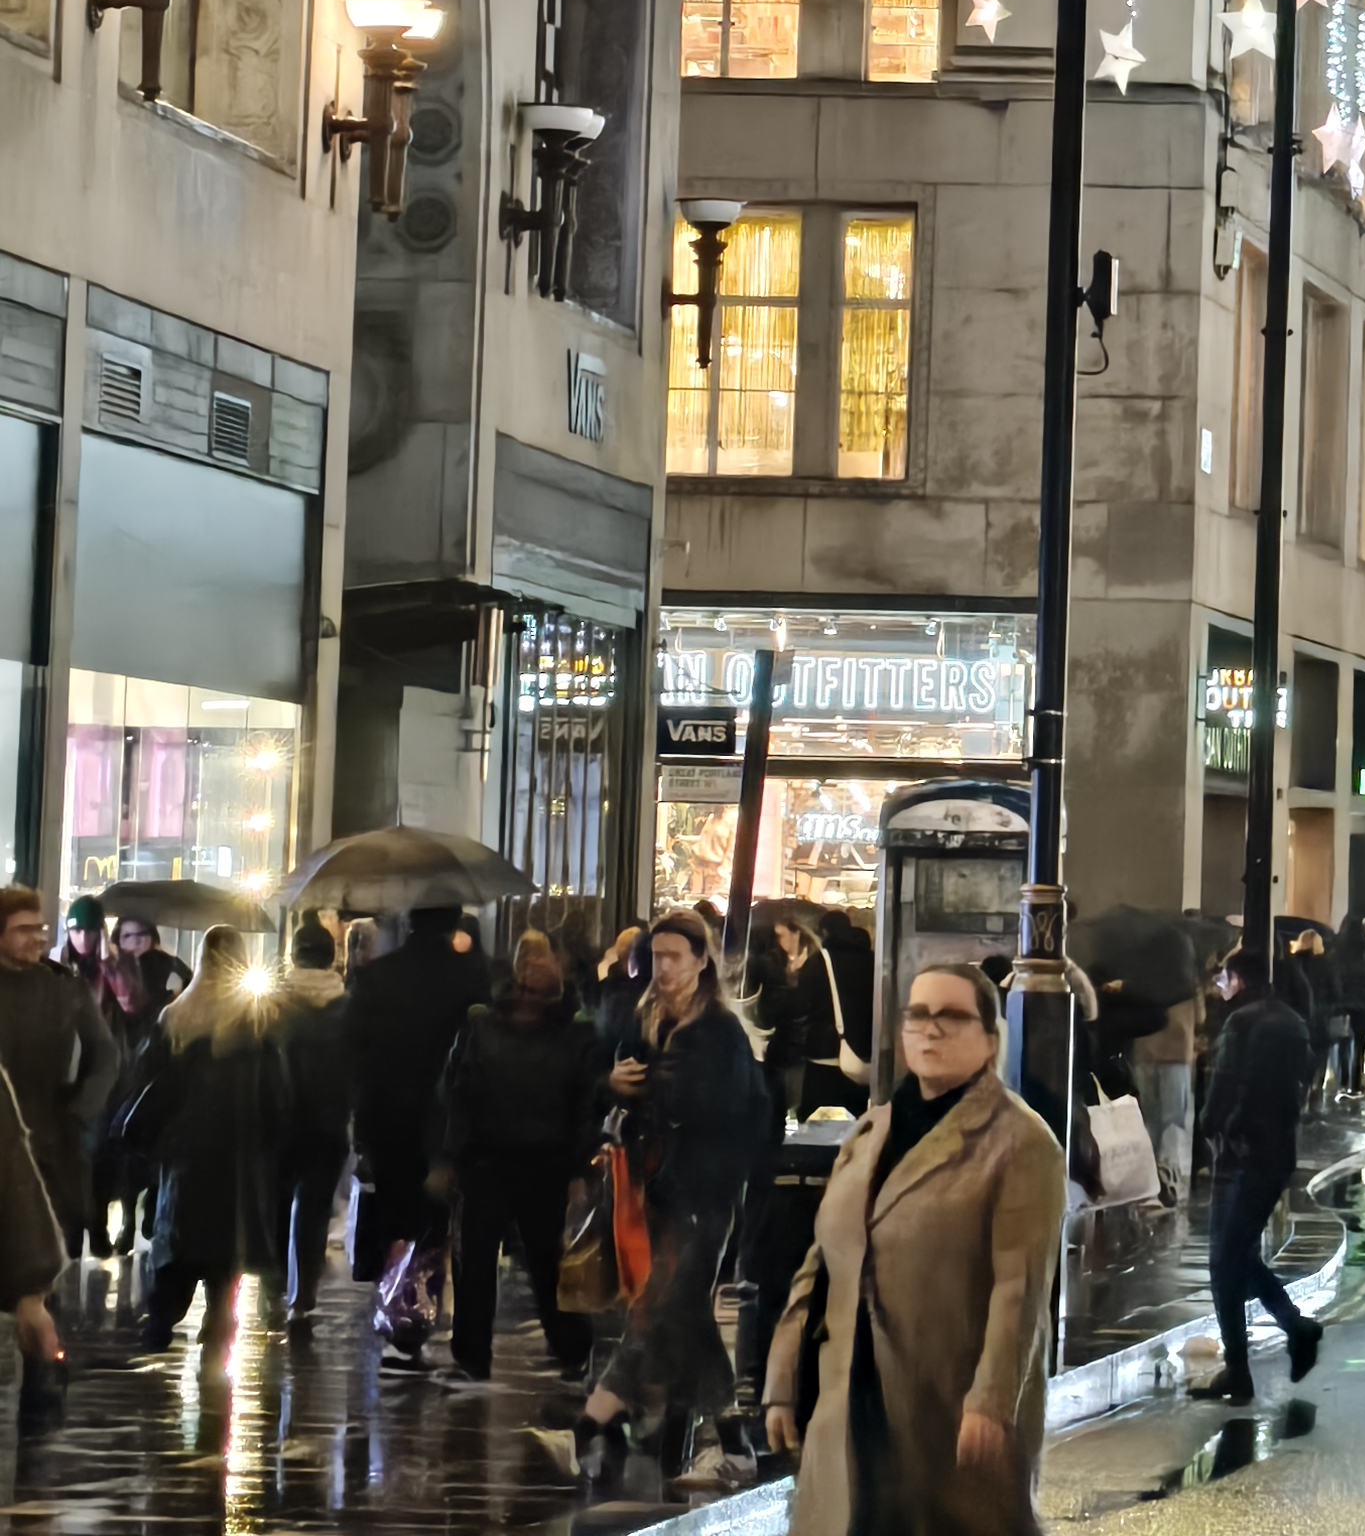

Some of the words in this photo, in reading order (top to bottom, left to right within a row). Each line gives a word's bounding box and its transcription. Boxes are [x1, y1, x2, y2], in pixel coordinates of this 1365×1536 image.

[567, 348, 607, 443] VANS
[722, 650, 997, 713] OTFITTERS
[666, 719, 730, 743] VANS
